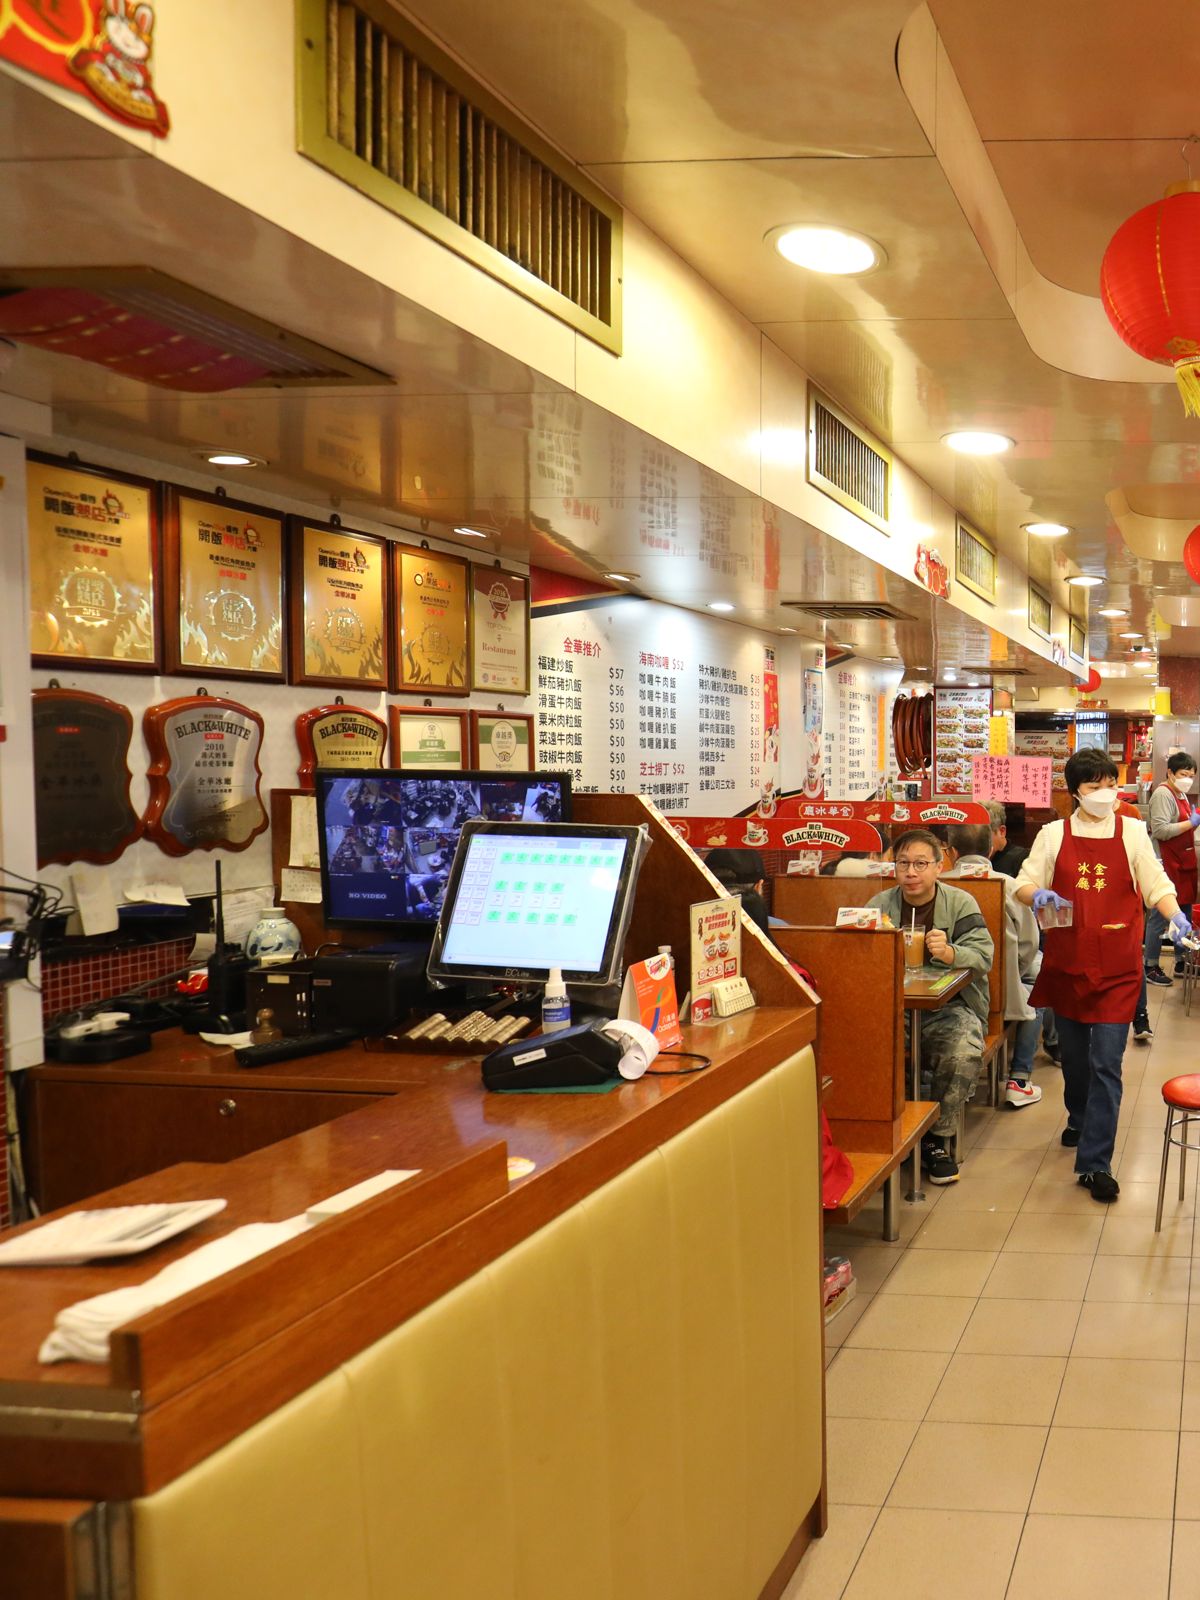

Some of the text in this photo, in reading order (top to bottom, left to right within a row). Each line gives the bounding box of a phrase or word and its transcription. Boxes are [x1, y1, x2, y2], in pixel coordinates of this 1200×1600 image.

[482, 642, 517, 656] Restaurant
[563, 636, 602, 658] 金華推介
[538, 656, 624, 679] 福建炒飯 $57
[639, 651, 684, 671] 海南咖喱 $52
[538, 674, 624, 696] 鮮茄豬扒飯 $56
[639, 673, 676, 688] 咖喱牛肉飯
[538, 693, 625, 713] 滑蛋牛肉飯 $50
[639, 705, 676, 720] 咖喱豬扒飯
[175, 720, 251, 740] BLACK&WHITE
[609, 718, 625, 730] $50
[639, 721, 676, 735] 咖喱雞扒飯
[319, 722, 378, 741] BLACK&WHITE
[539, 731, 625, 747] 菜遠牛肉飯 $50
[639, 737, 677, 750] 咖喱雞翼飯
[205, 743, 224, 751] 2010
[539, 750, 625, 764] 豉椒牛肉飯 $50
[610, 769, 625, 781] $50
[639, 761, 685, 777] 芝士撈丁 $52
[653, 797, 690, 810] 咖喱雞扒撈丁
[803, 806, 851, 817] 金華冰廳
[921, 810, 966, 821] BLACK&WHITE
[808, 822, 822, 830] 黑白
[785, 829, 847, 845] BLACK&WHITE
[348, 892, 360, 900] NO
[657, 1021, 677, 1033] Octopus
